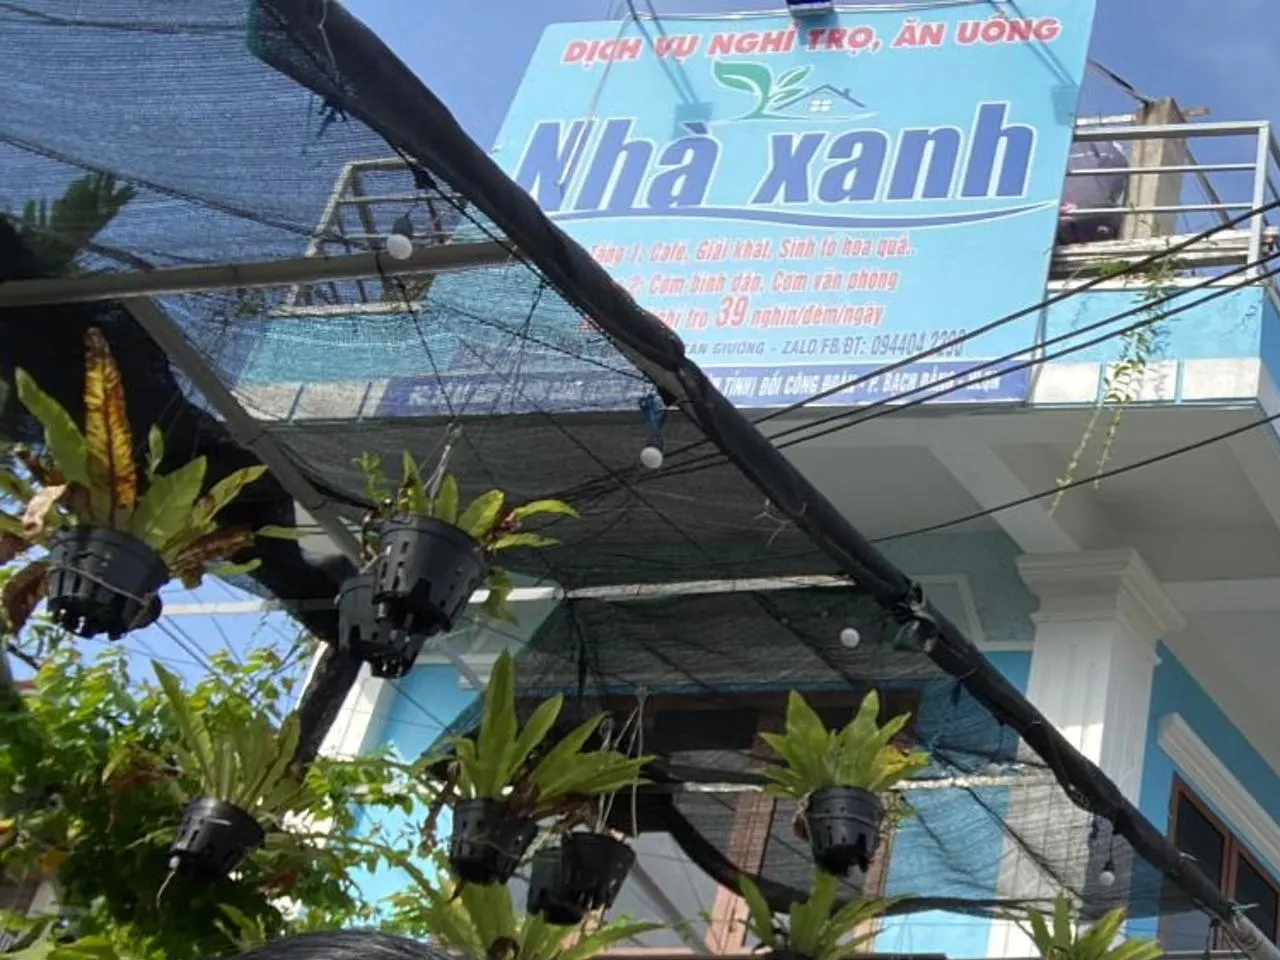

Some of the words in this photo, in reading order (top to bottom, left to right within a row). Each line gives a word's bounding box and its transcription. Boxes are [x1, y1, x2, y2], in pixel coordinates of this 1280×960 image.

[561, 38, 643, 69] DỊCH
[891, 17, 946, 48] ĂN
[511, 117, 722, 212] Nhà
[747, 102, 1036, 207] xanh
[715, 296, 750, 327] 39
